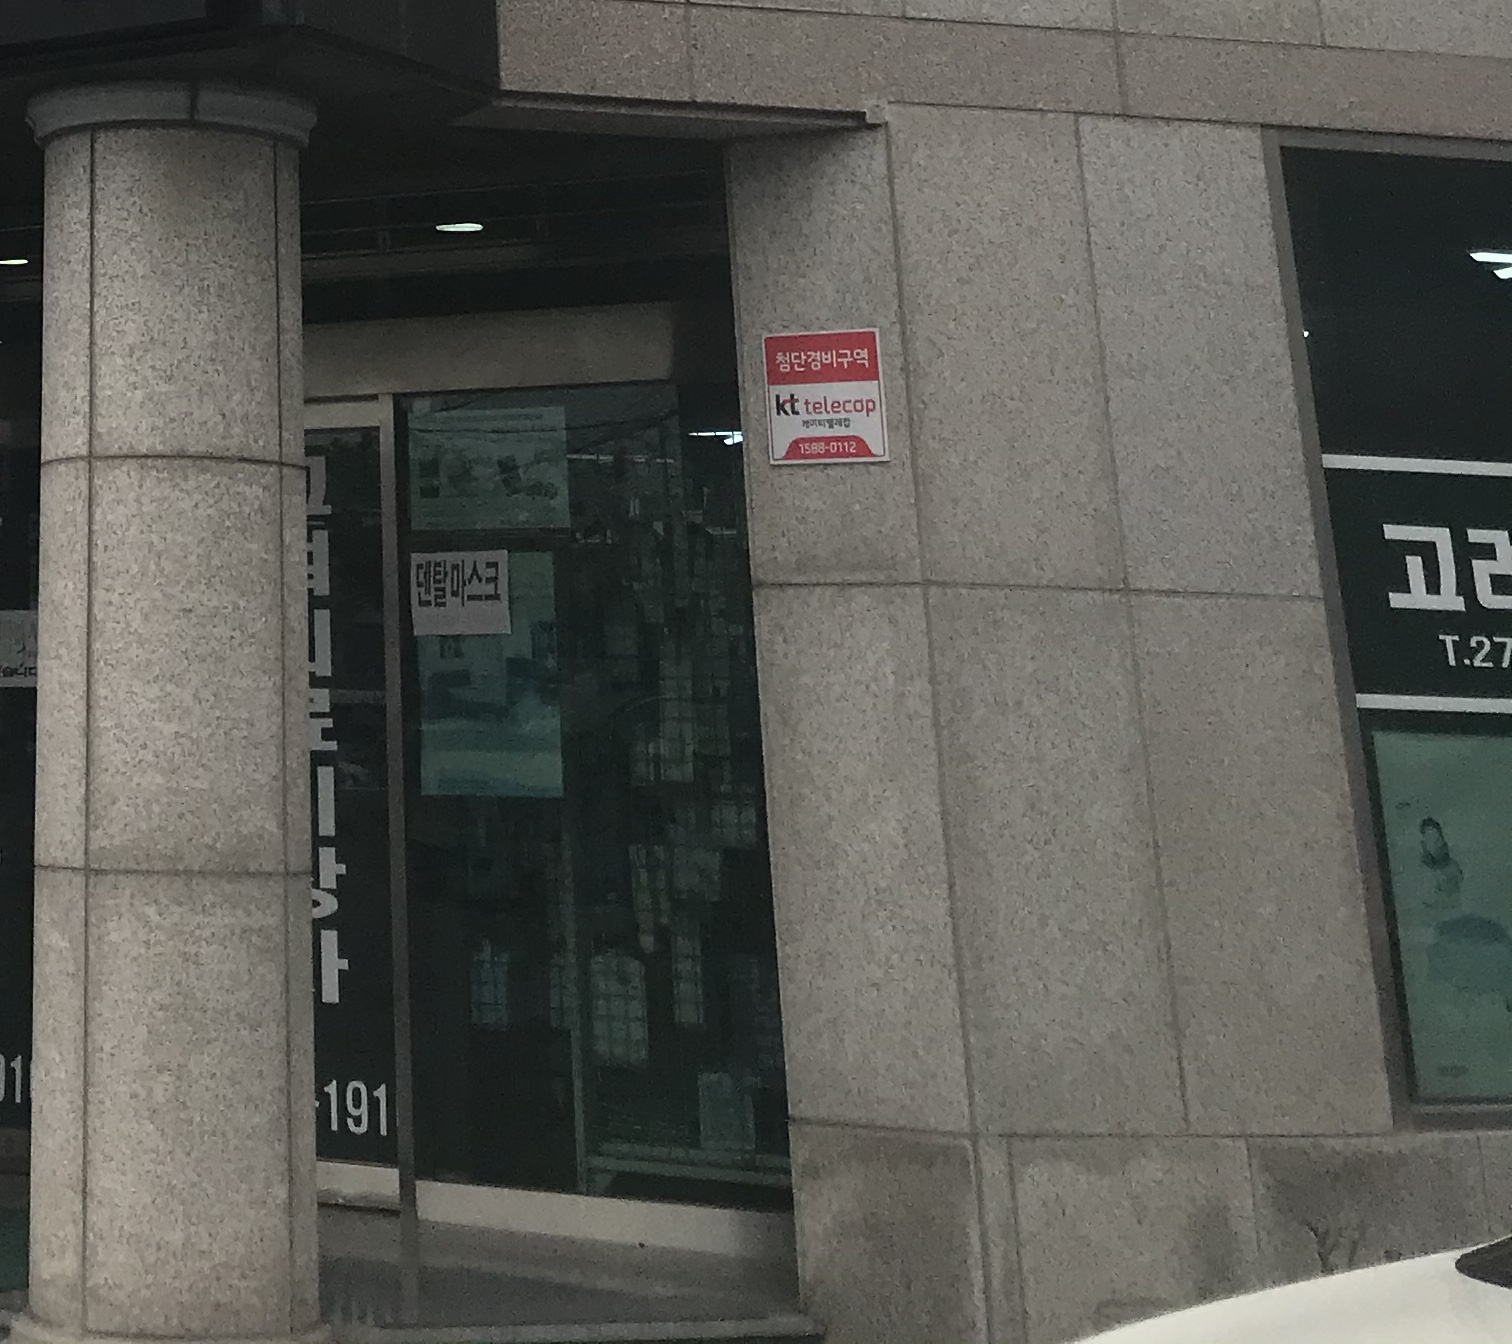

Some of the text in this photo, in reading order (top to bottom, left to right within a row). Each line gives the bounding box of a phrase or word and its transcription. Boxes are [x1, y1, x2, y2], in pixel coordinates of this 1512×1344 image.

[775, 347, 870, 373] 첨단경비구역
[775, 392, 877, 418] kt telecop
[798, 440, 857, 455] 1588-0112
